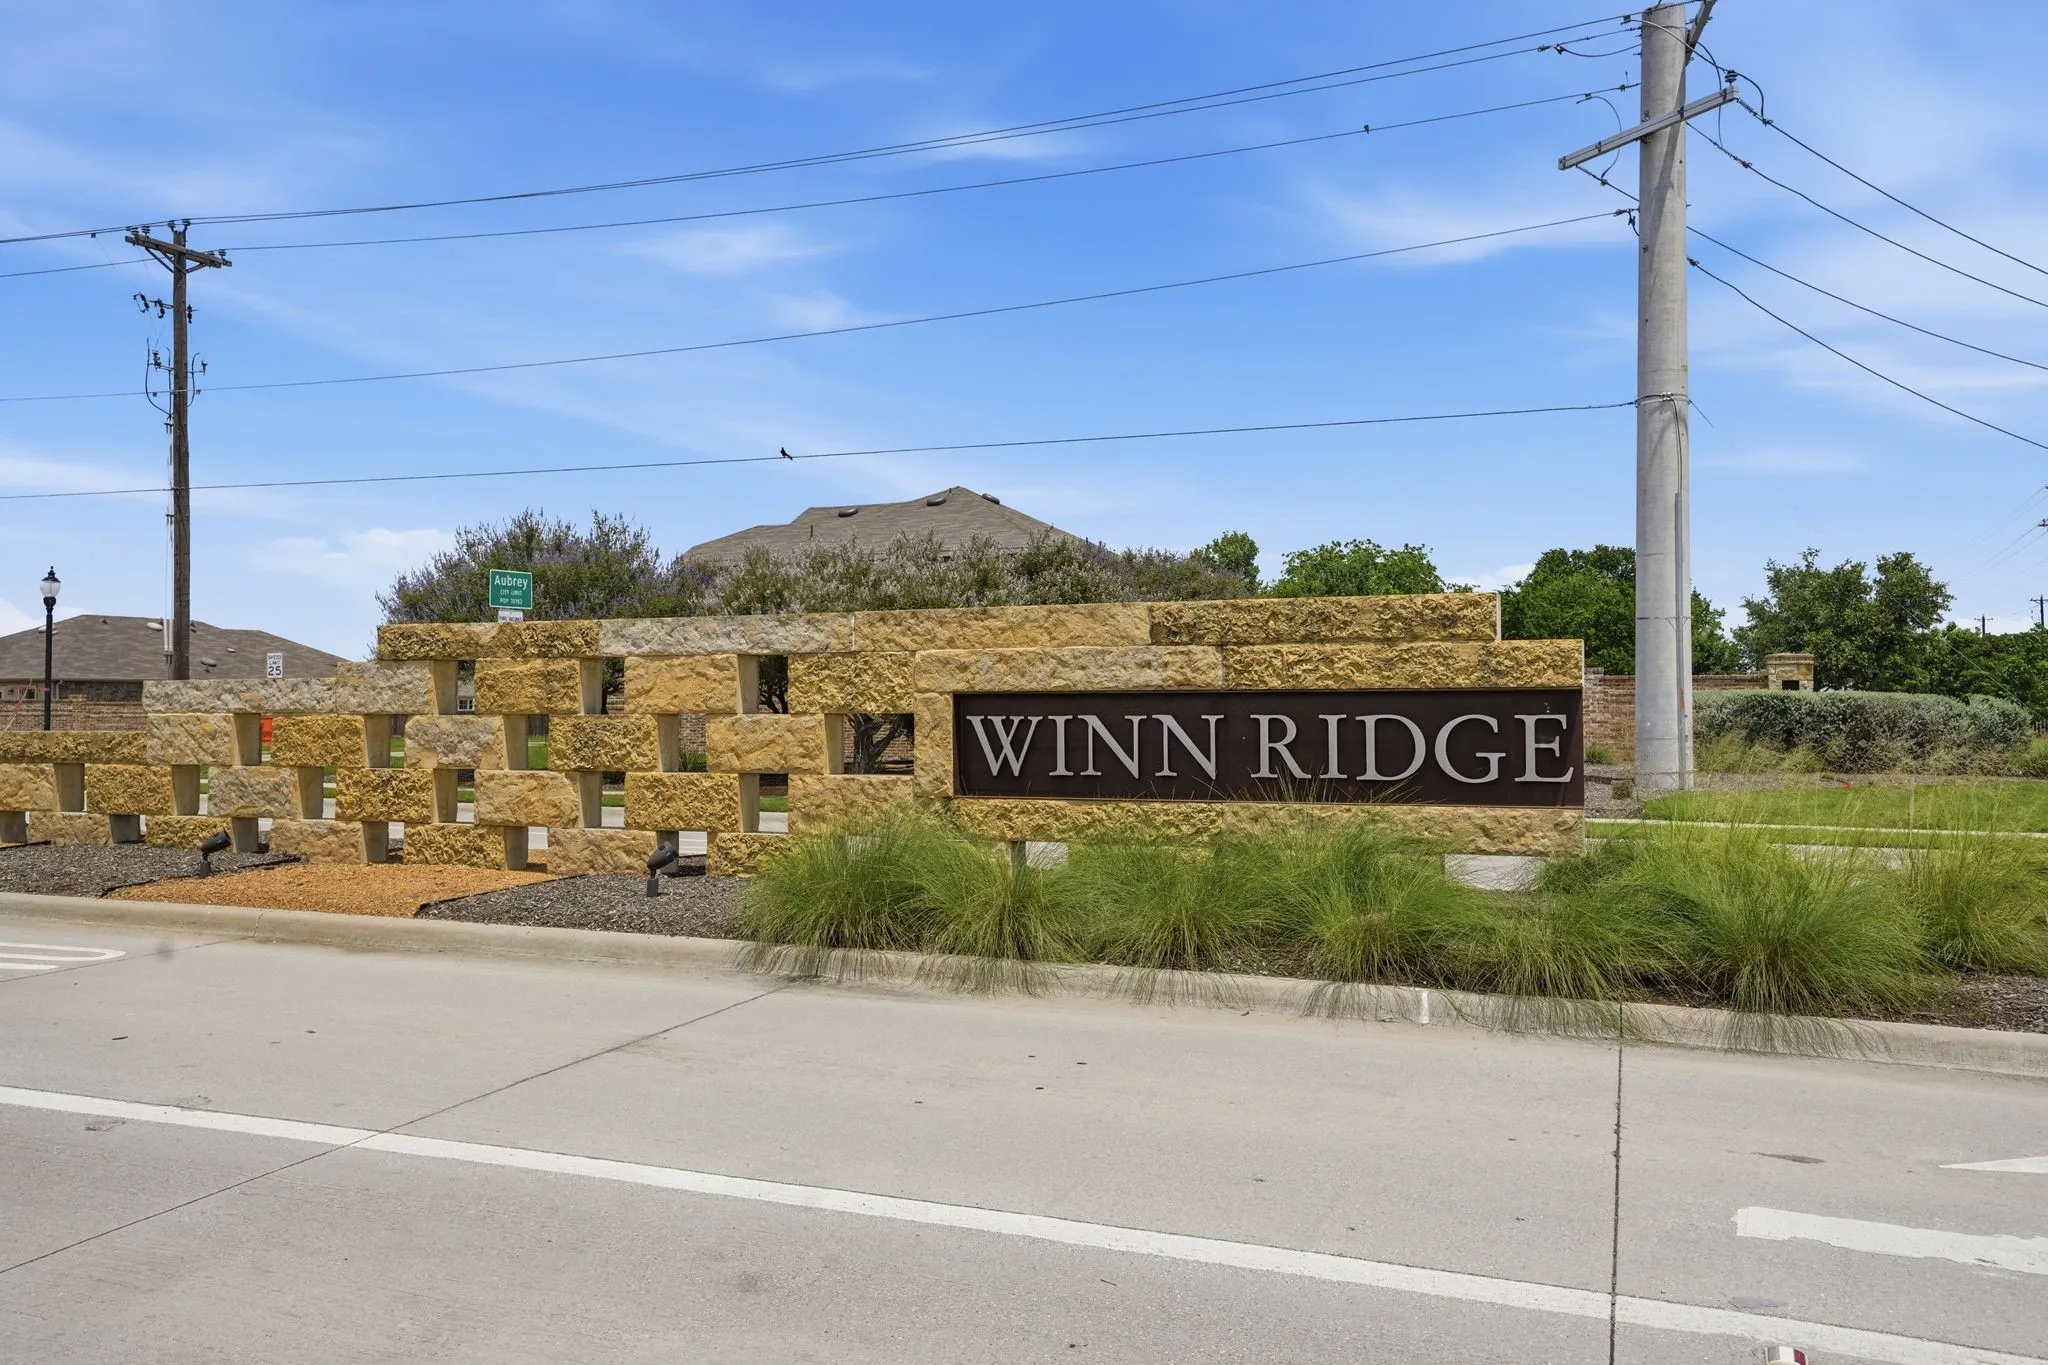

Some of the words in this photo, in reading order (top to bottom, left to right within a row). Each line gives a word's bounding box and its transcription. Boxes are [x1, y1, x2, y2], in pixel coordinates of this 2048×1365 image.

[494, 575, 528, 590] Aubrey
[268, 666, 281, 676] 25
[965, 714, 1224, 779] WINN
[1250, 714, 1574, 784] RIDGE
